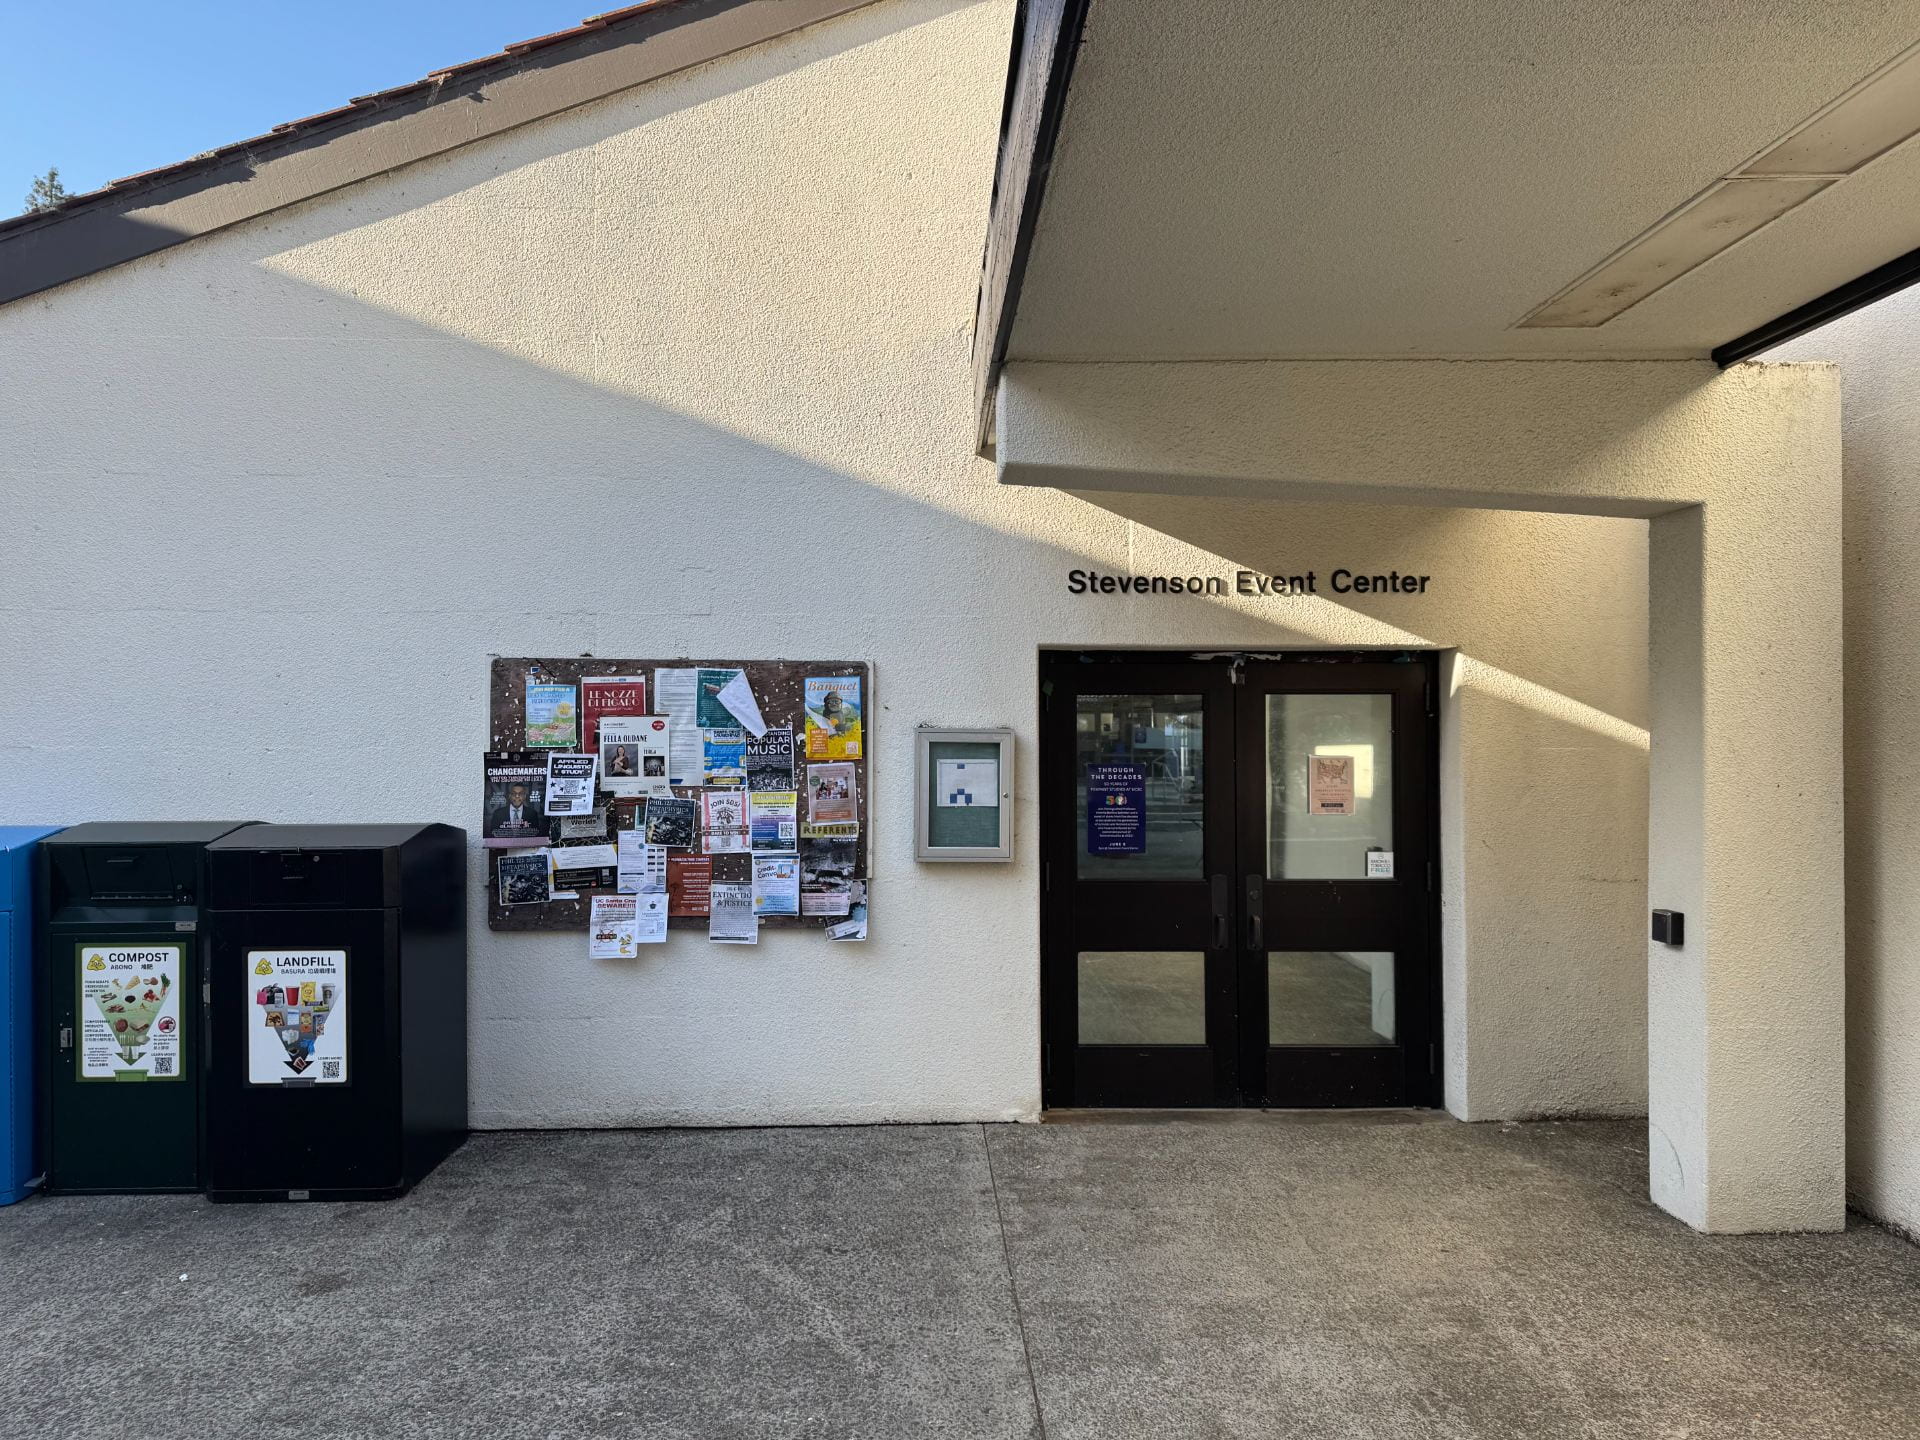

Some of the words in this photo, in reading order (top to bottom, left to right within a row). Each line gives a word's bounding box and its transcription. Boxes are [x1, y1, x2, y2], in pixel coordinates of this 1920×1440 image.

[1067, 569, 1221, 594] Stevenson
[1236, 570, 1316, 594] Event
[1331, 568, 1430, 594] Center
[589, 690, 600, 699] LE
[604, 690, 639, 699] NOZZE
[588, 699, 601, 707] DI
[602, 698, 640, 707] FIGARO
[747, 736, 790, 745] POPULAR
[747, 745, 790, 756] MUSIC
[487, 767, 547, 776] CHANGEMAKERS
[710, 799, 724, 809] JOIN
[803, 825, 858, 834] REFERENTS
[723, 900, 752, 908] JUSTICE
[108, 952, 170, 963] COMPOST
[276, 956, 335, 967] LANDFILL
